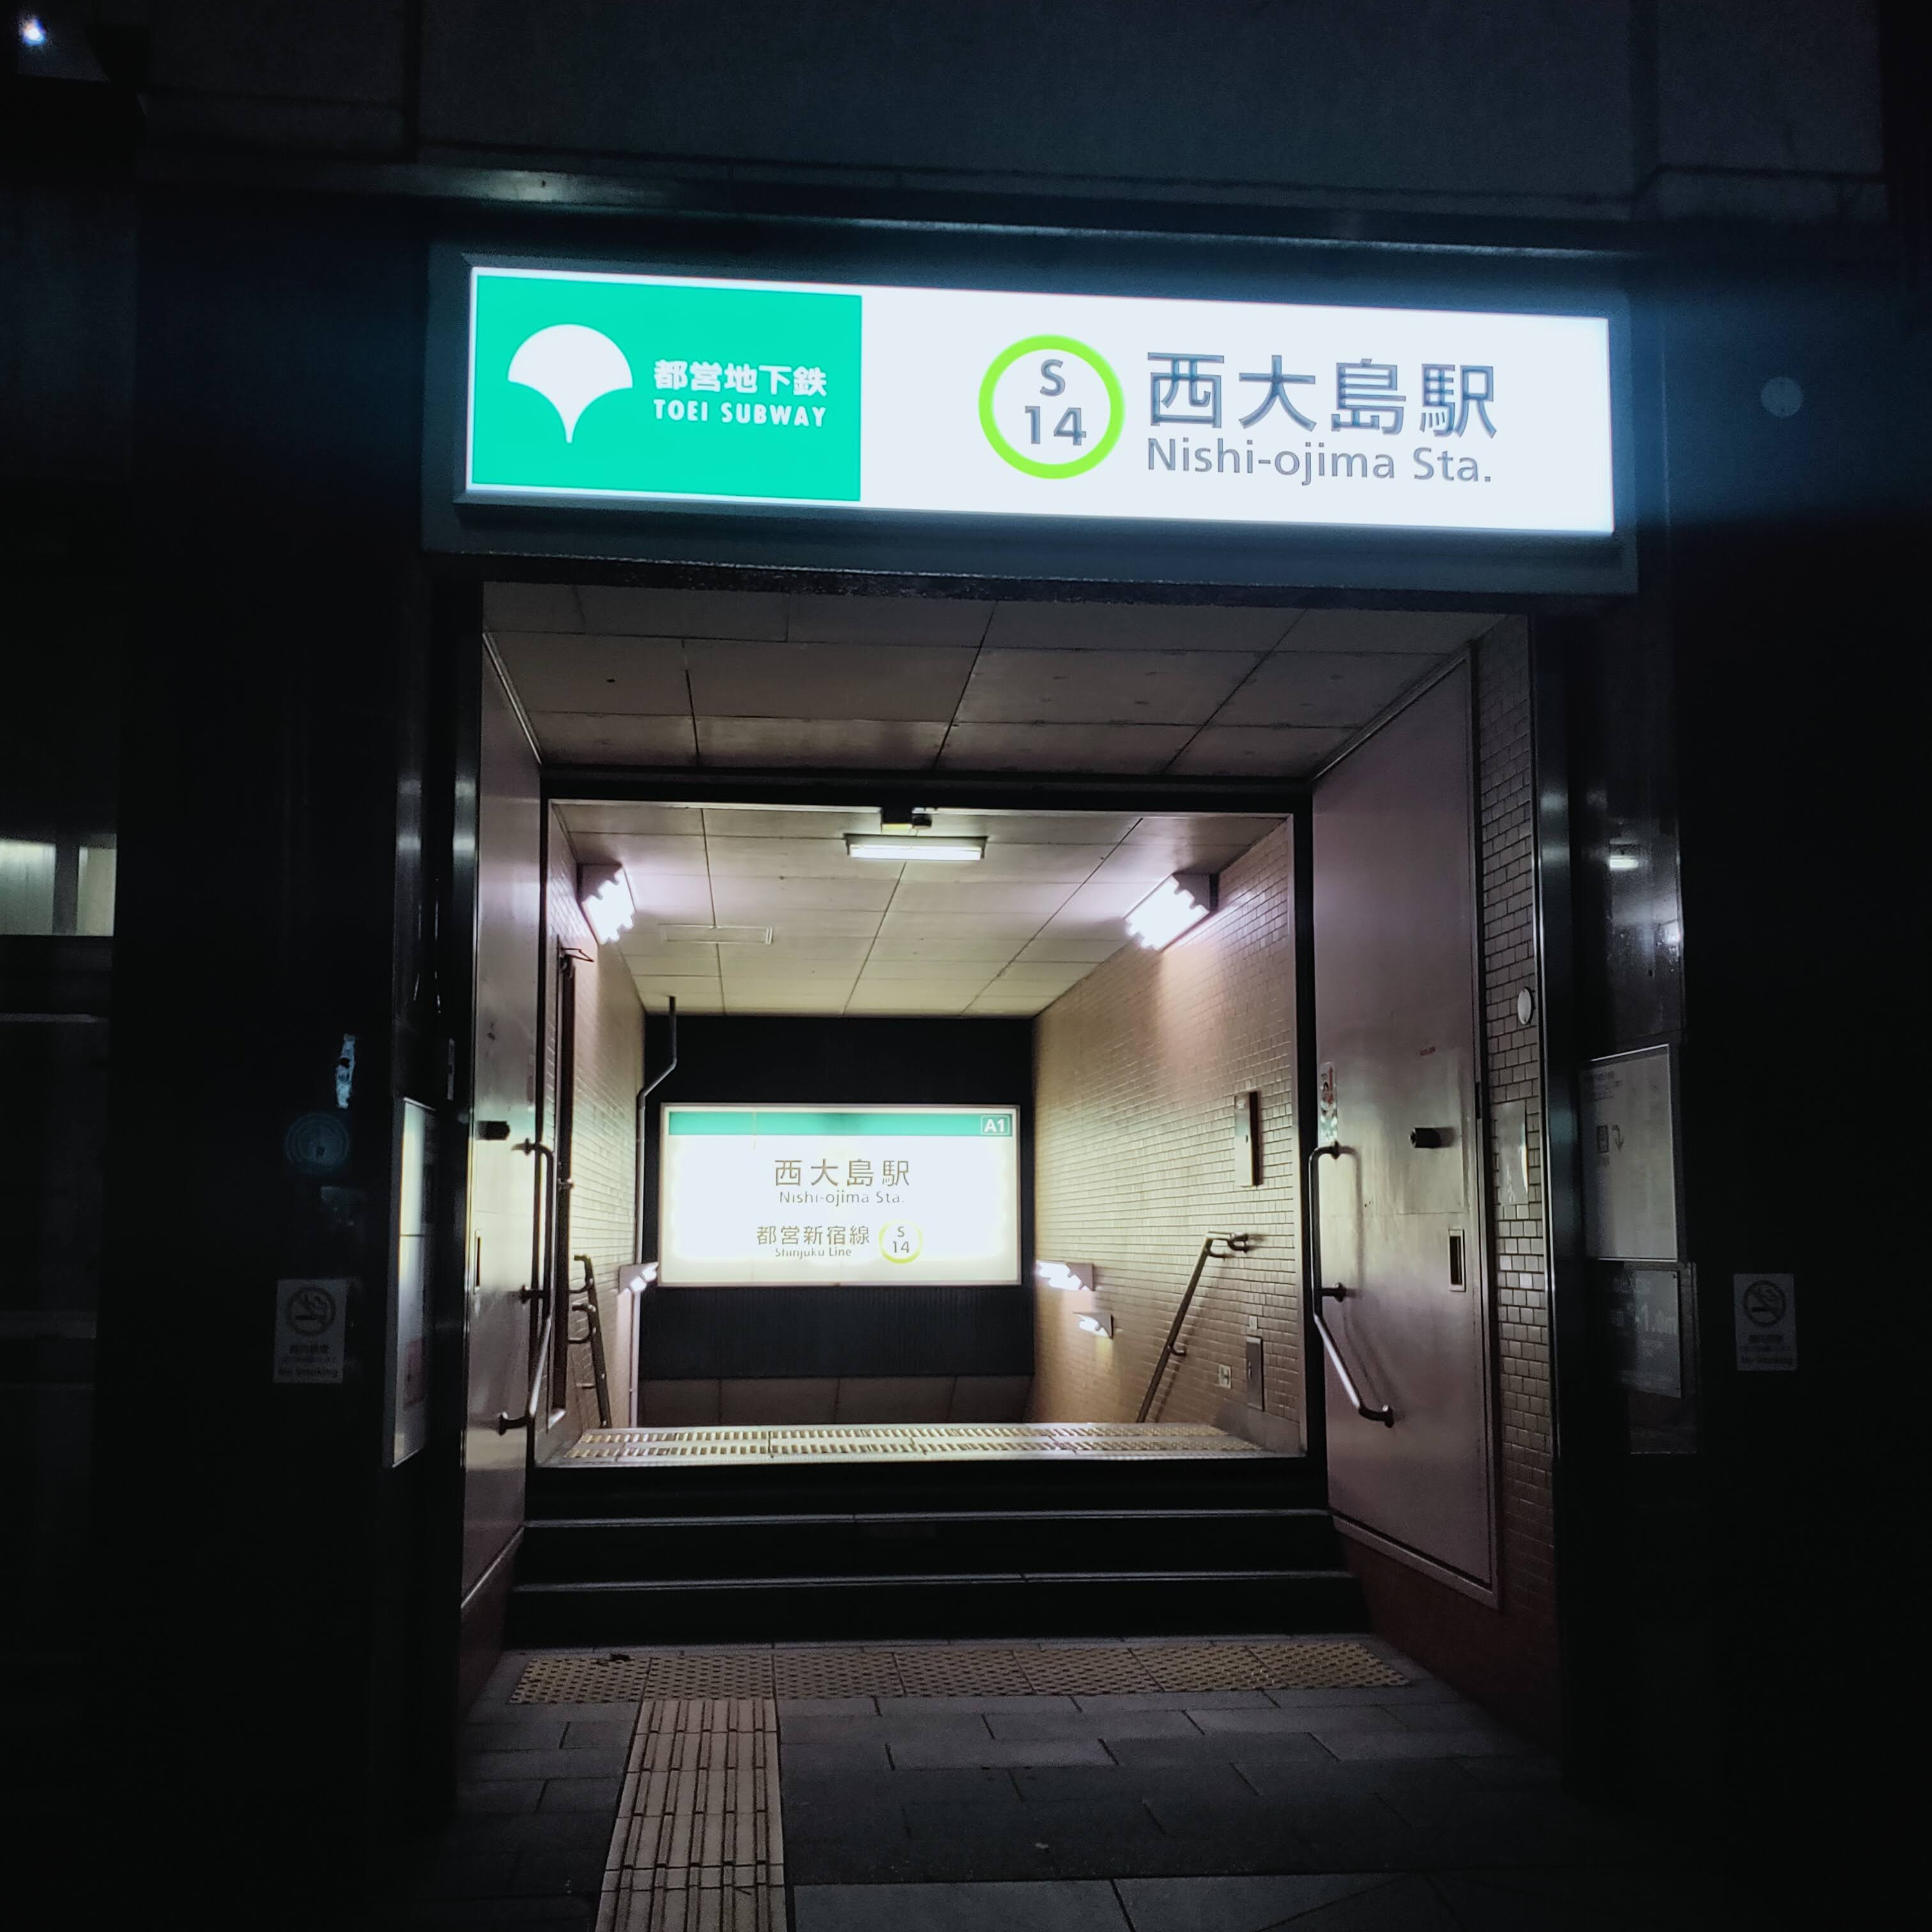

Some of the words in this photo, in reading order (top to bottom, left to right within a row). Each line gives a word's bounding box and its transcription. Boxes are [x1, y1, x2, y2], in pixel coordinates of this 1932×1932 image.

[654, 359, 827, 397] 都営地下鉄
[1039, 359, 1066, 397] S
[1147, 352, 1497, 439] 西大島駅
[654, 399, 708, 421] TOEI
[721, 402, 826, 427] SUBWAY
[1024, 405, 1087, 446] 14
[1148, 437, 1395, 486] Nishi-ojima
[1412, 446, 1492, 482] Sta.
[983, 1118, 1005, 1133] A1
[774, 1159, 909, 1187] 西大島駅
[779, 1190, 869, 1207] Nishi-ojima
[876, 1191, 904, 1203] Sta.
[757, 1225, 869, 1245] 都営新宿線
[896, 1226, 905, 1238] S
[775, 1247, 825, 1260] Shinjuku
[829, 1247, 852, 1257] Line
[892, 1240, 910, 1254] 14
